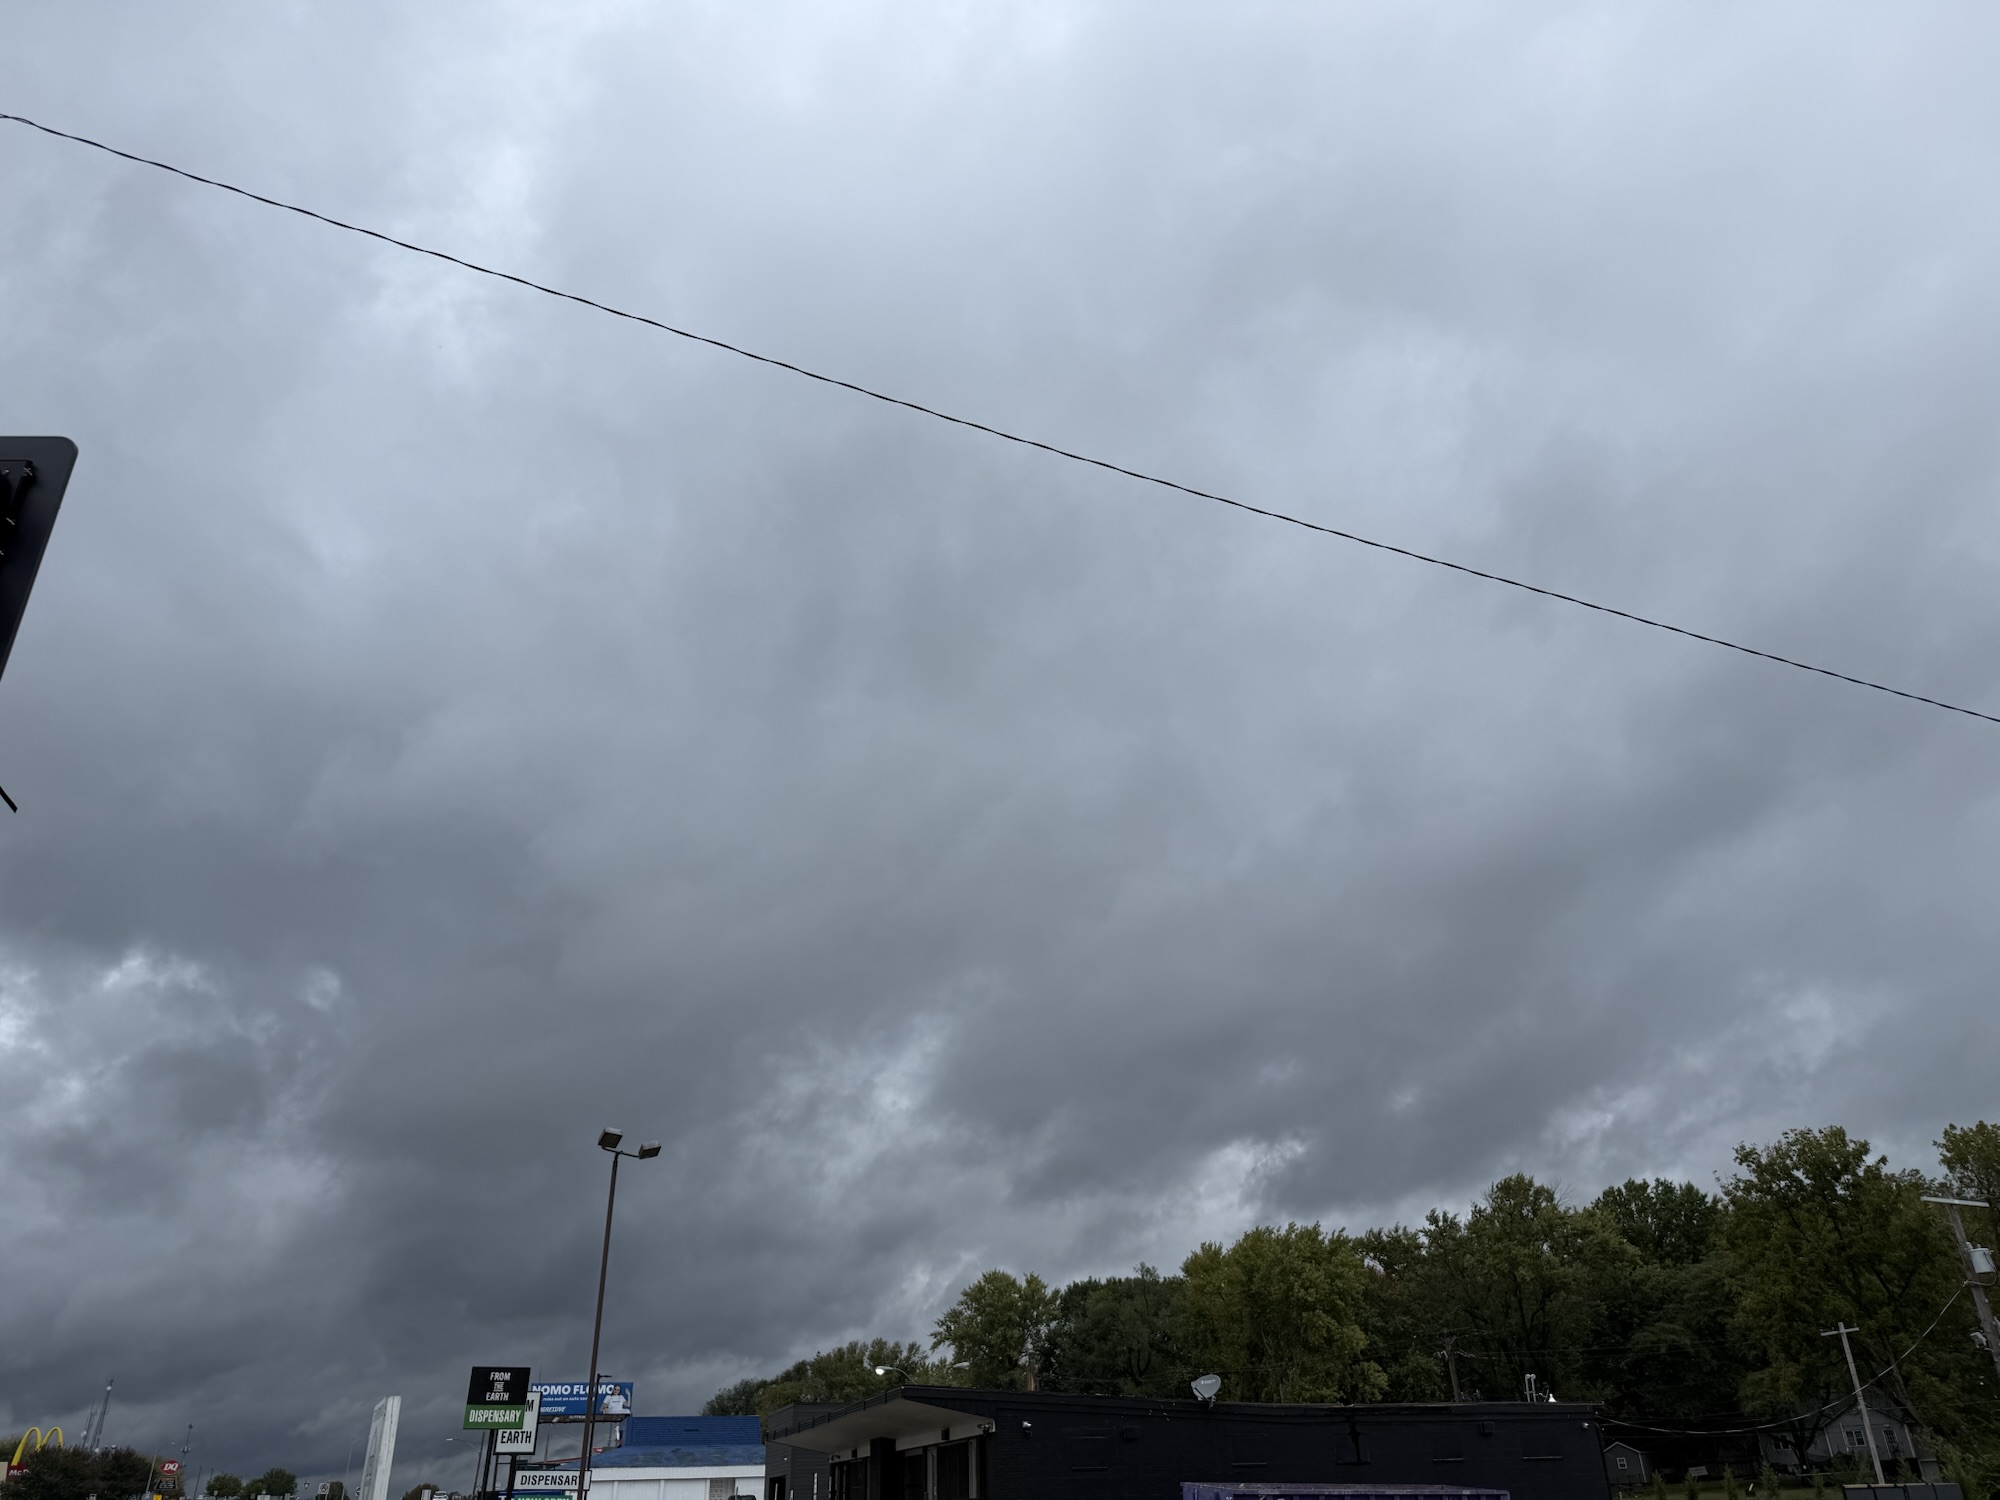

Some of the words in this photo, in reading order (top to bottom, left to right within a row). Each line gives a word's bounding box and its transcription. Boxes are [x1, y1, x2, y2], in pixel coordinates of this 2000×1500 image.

[490, 1372, 511, 1381] FROM
[532, 1385, 571, 1395] NOMO
[486, 1392, 509, 1401] EARTH
[469, 1409, 521, 1423] DISPENSARY
[500, 1430, 532, 1444] EARTH
[163, 1463, 179, 1472] DQ
[520, 1475, 581, 1486] DISPENSAR
